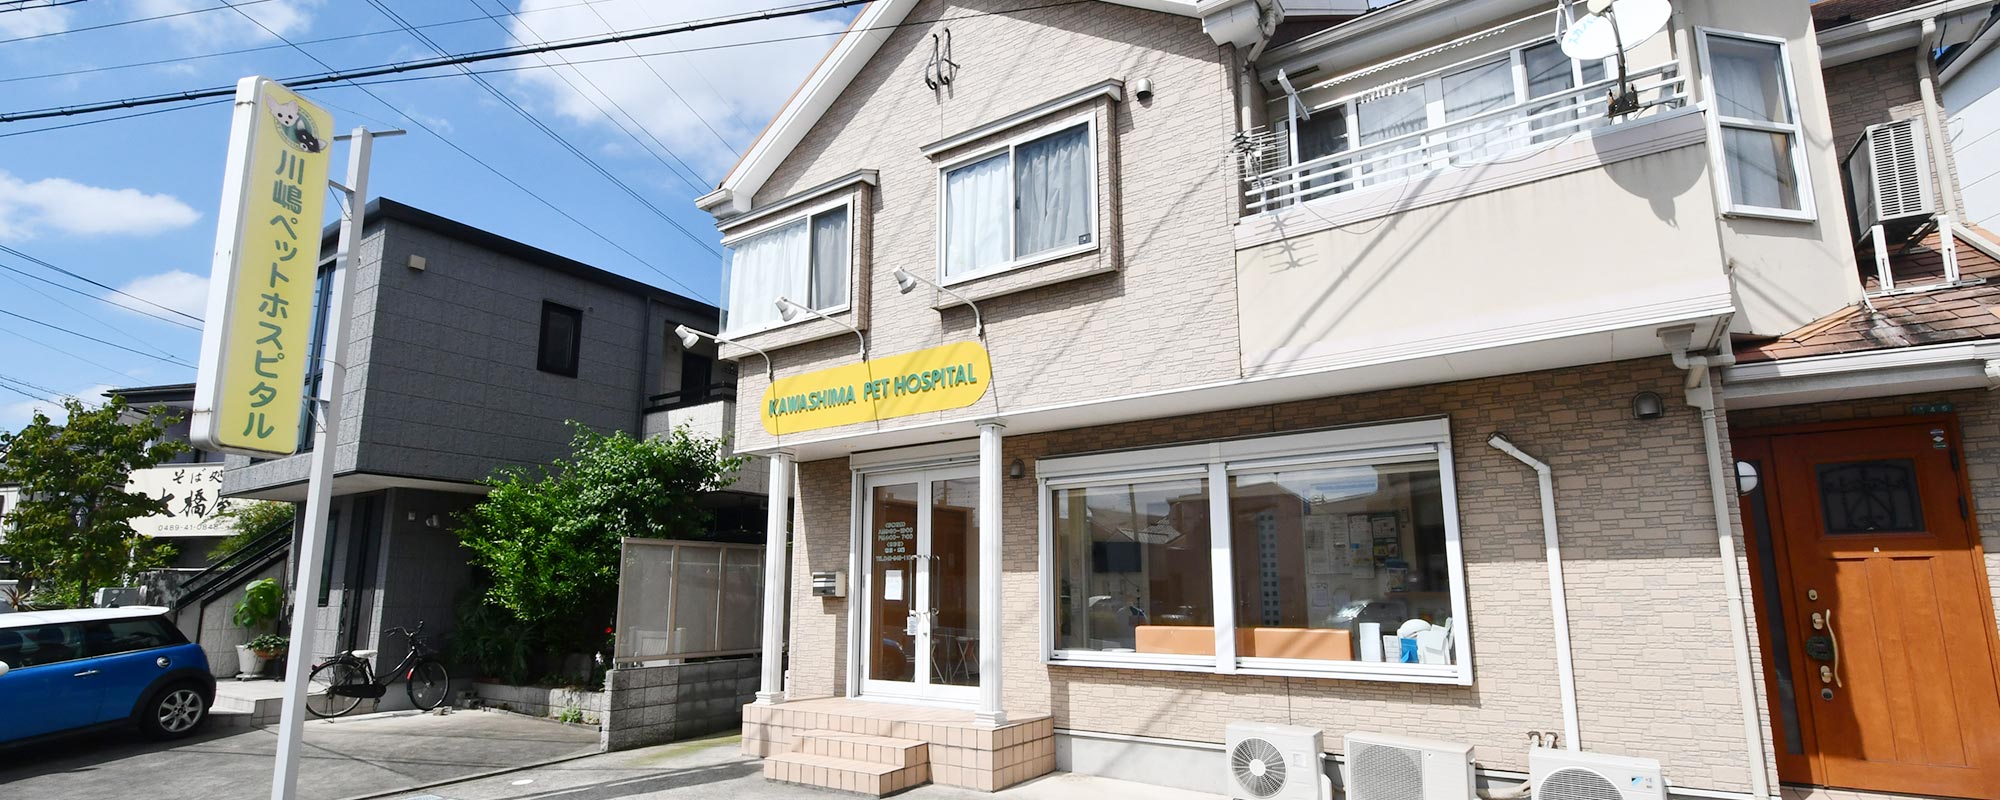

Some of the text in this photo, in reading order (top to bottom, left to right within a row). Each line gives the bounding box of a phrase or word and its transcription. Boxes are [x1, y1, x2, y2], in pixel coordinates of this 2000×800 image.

[242, 149, 306, 440] 川嶋ペットホスピタル
[768, 362, 978, 418] KAWASHIMA PET HOSPITAL
